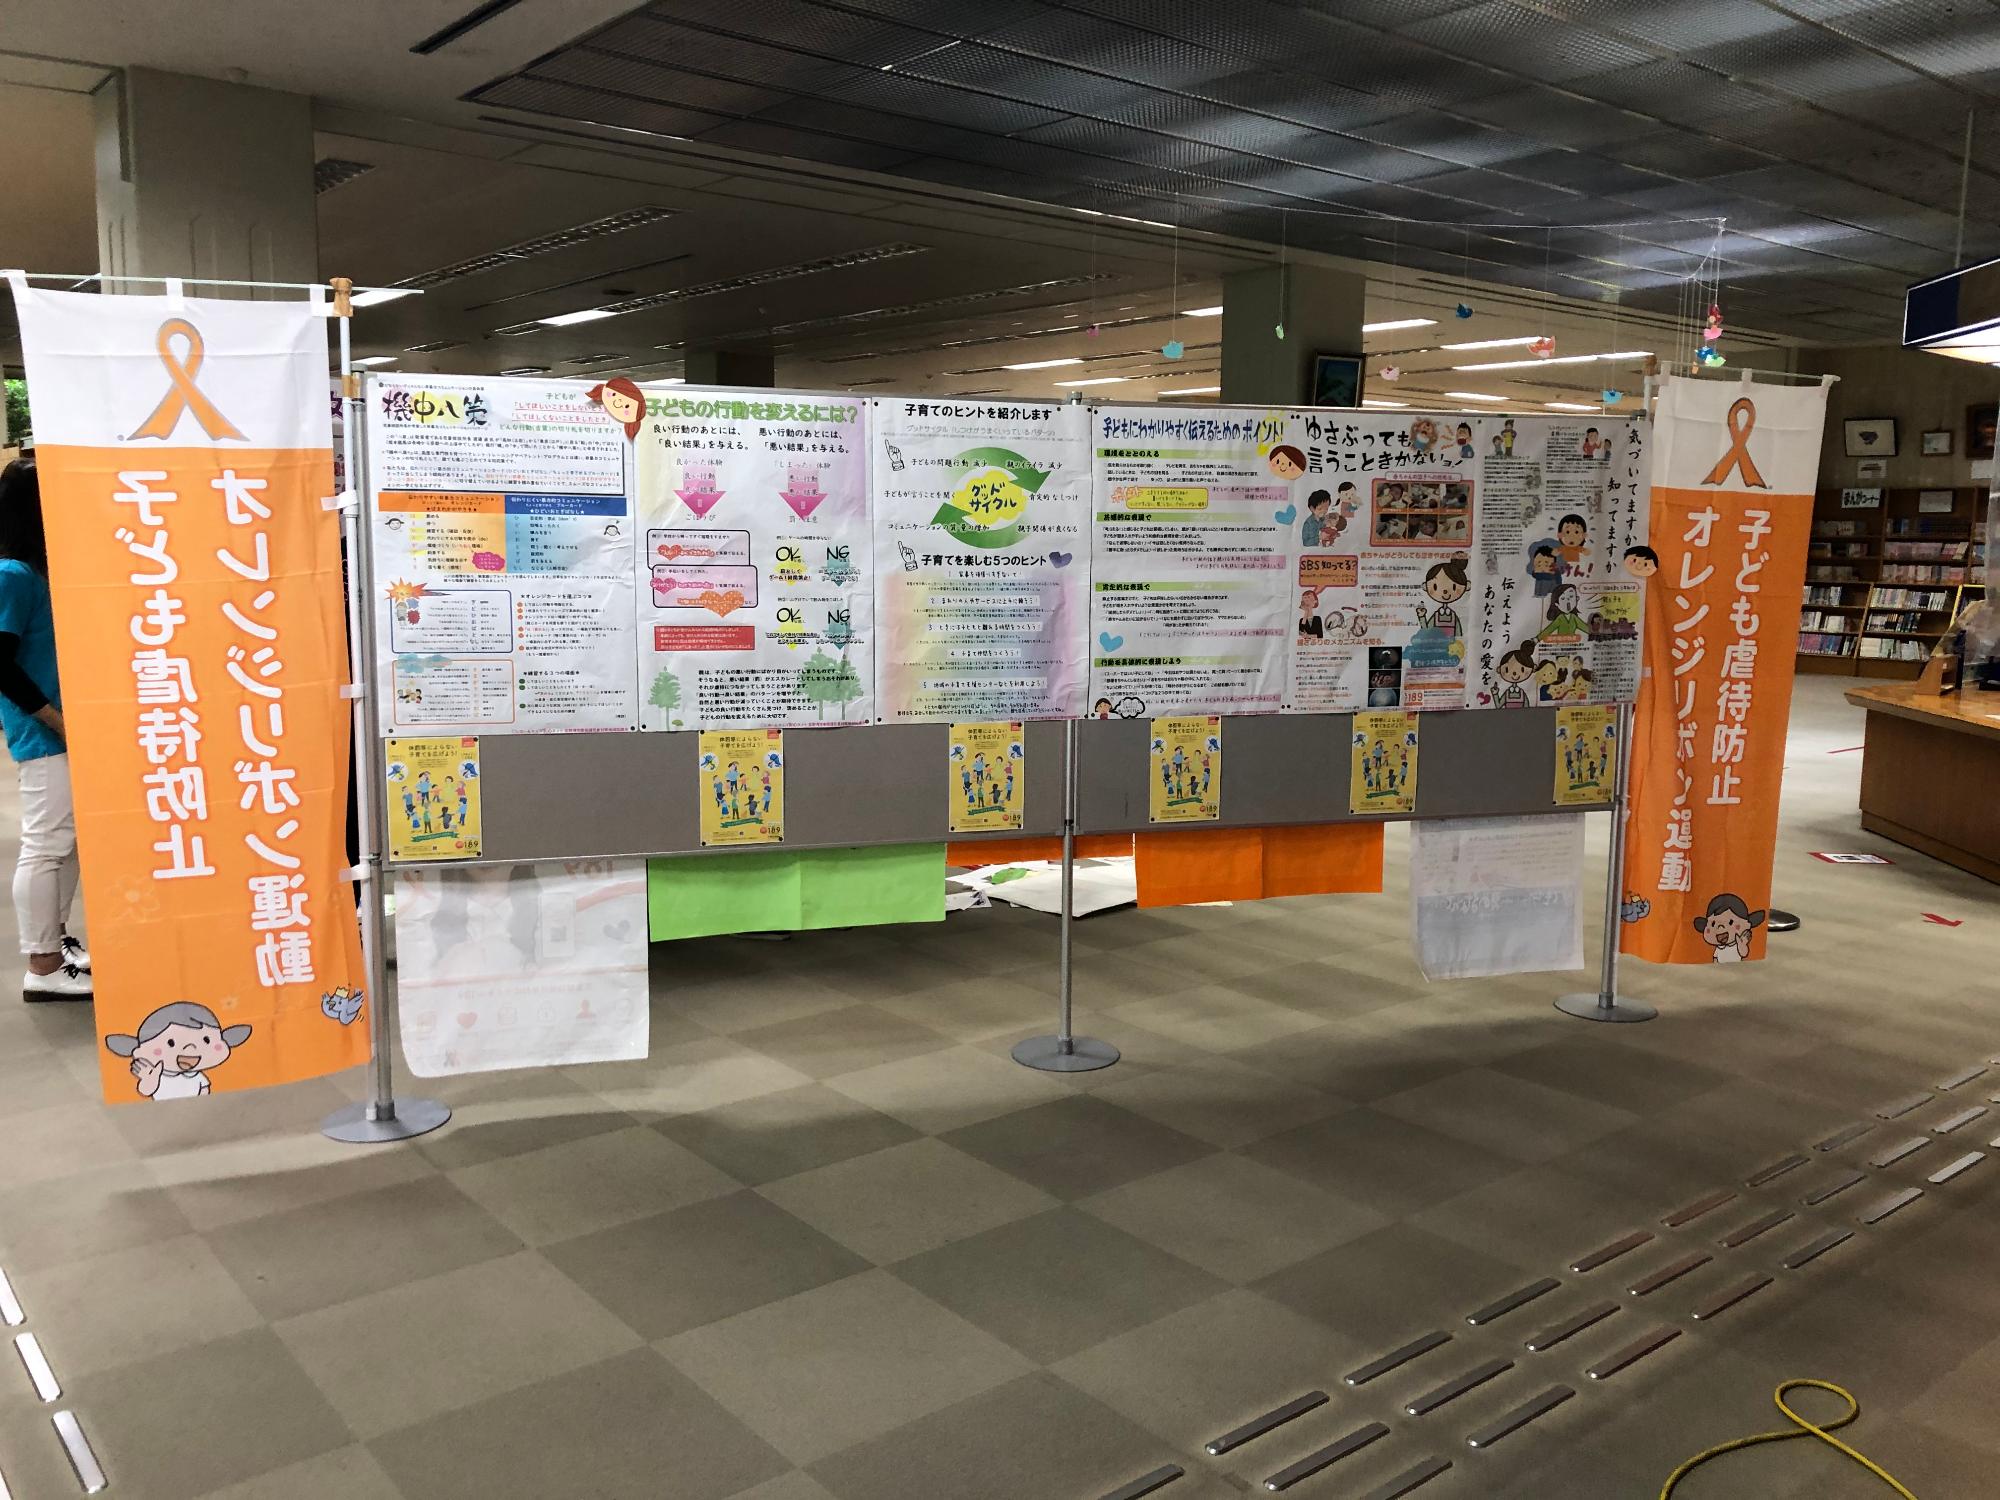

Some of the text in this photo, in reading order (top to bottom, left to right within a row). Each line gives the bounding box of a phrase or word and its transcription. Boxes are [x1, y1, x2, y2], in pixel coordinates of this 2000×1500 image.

[545, 392, 577, 400] 子どもが
[904, 403, 1053, 421] 子育てのヒントを紹介します
[653, 424, 744, 437] 良い行動のあとには、
[758, 427, 844, 441] 悪い行動のあとには、
[1305, 415, 1412, 448] ゆさぶっても
[657, 438, 751, 451] 「良い結果」を与える。
[763, 441, 851, 454] 「悪い結果」を与える。
[911, 458, 969, 468] 子どもの問題行動
[884, 490, 956, 500] 子どもが言うことを聞く
[971, 481, 1006, 500] グッド
[1624, 428, 1643, 547] 気づいてますか
[969, 496, 1018, 515] サイクル
[1605, 477, 1622, 574] 知ってますか
[775, 546, 801, 562] OK
[826, 545, 850, 561] NG
[776, 607, 802, 623] OK
[827, 608, 851, 625] NG
[1502, 576, 1516, 645] 伝えよう
[1480, 584, 1496, 686] あなたの愛を
[1706, 508, 1773, 806] 子ども虐待防止
[1656, 505, 1721, 893] オレンジリボン運動
